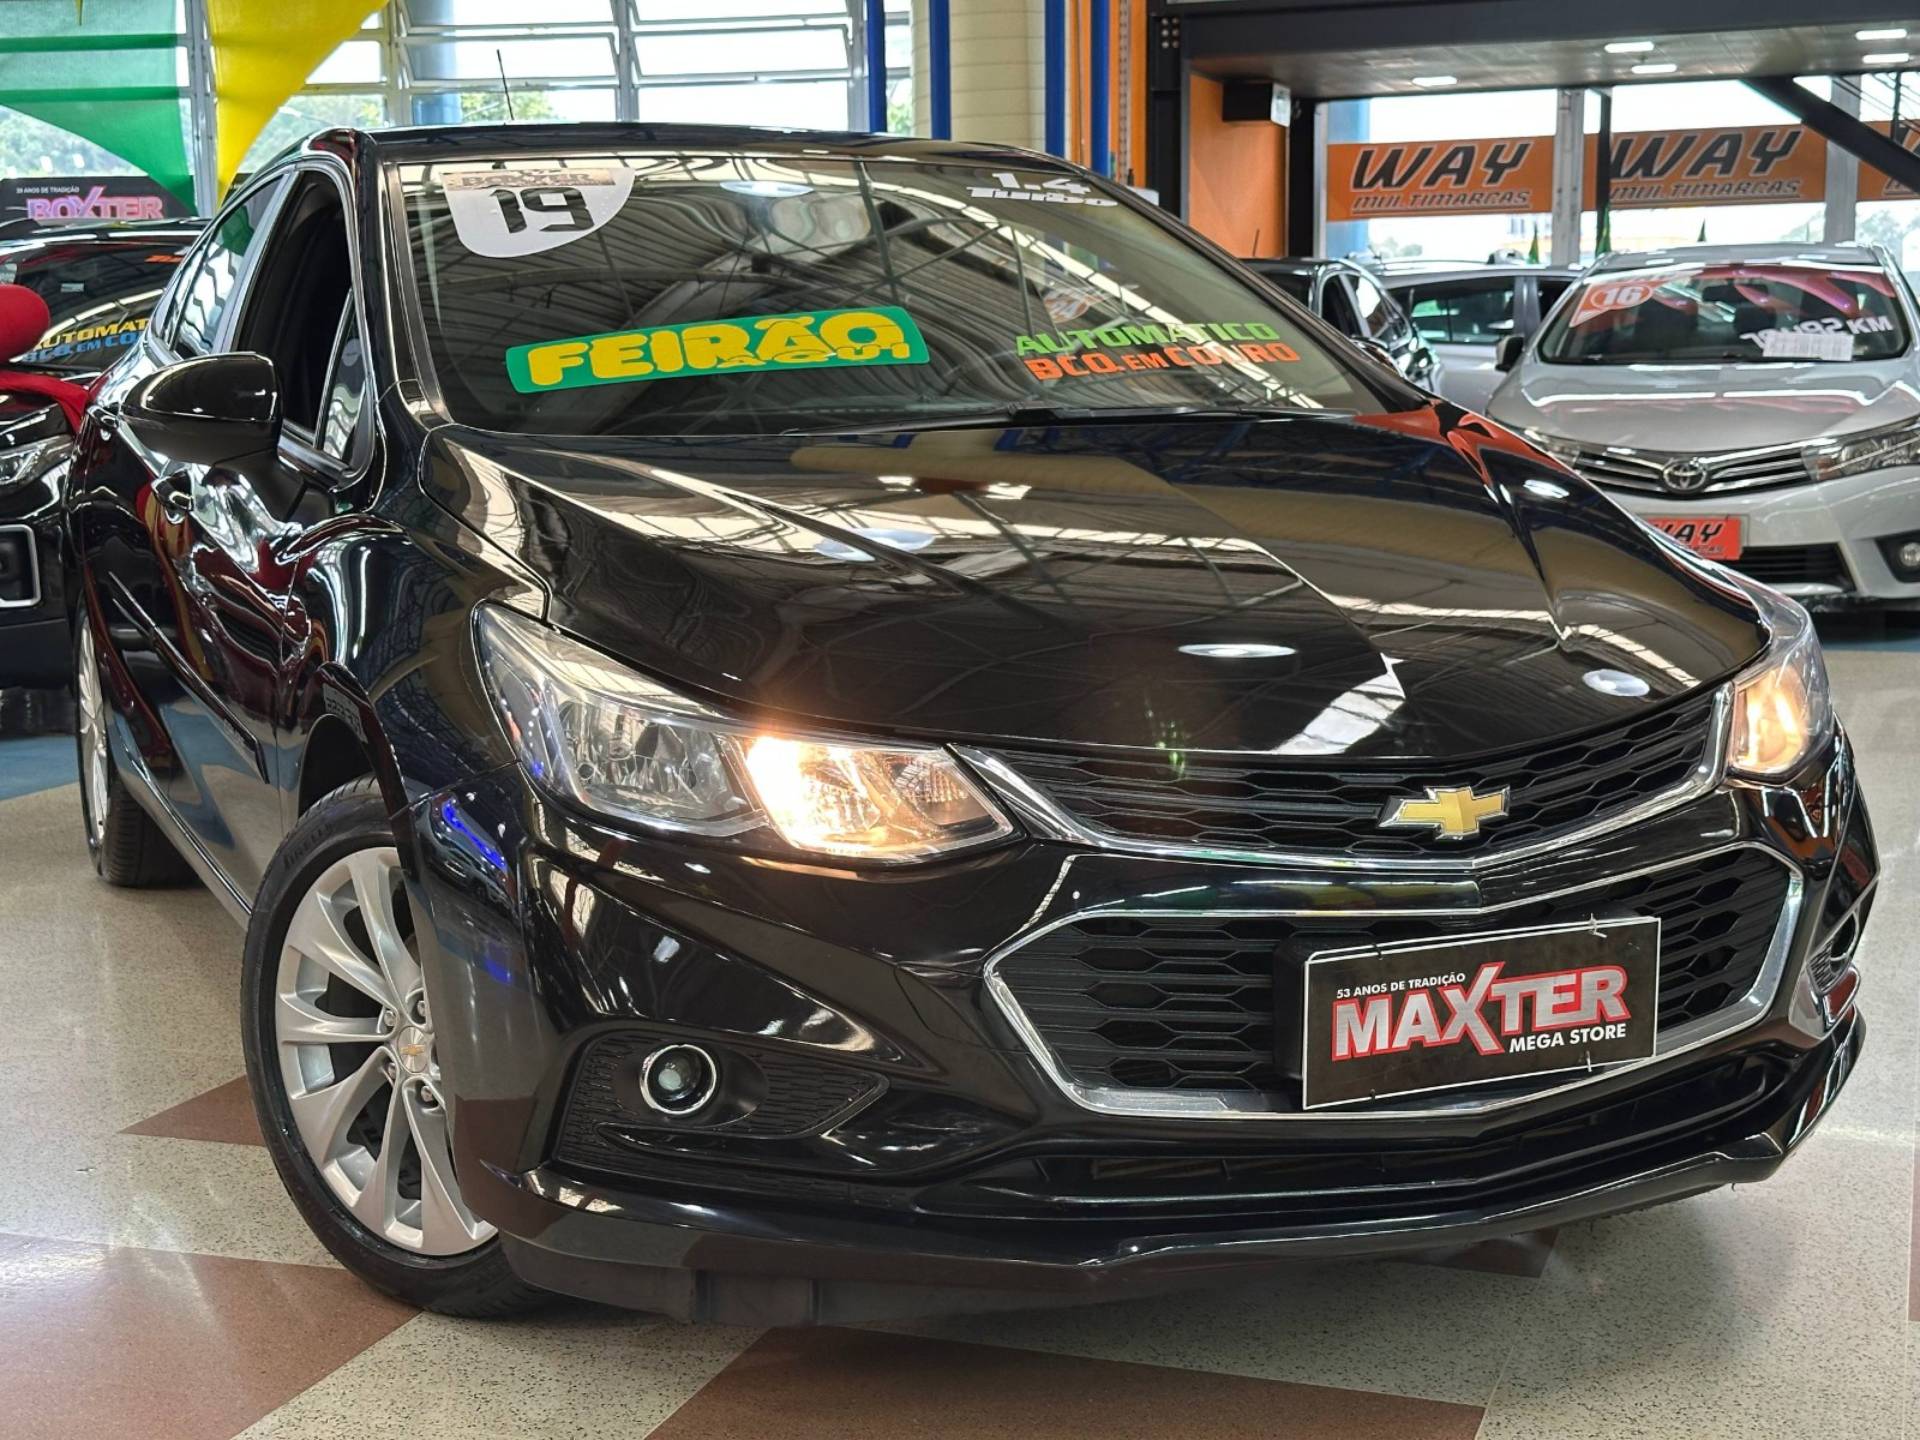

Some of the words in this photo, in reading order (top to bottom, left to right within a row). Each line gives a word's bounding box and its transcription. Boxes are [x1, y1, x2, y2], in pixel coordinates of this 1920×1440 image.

[1351, 140, 1534, 192] WAY
[1610, 128, 1803, 180] WAY
[992, 172, 1092, 195] 1.4
[1353, 189, 1531, 210] MULTIMARCAS
[26, 185, 164, 220] BOXTER
[490, 186, 595, 234] 19
[1603, 286, 1644, 306] 16
[34, 318, 149, 351] AUTOMAT
[1846, 315, 1894, 334] KM
[526, 312, 905, 386] FEIRÃO
[1120, 352, 1170, 372] EM
[1164, 341, 1300, 367] COURO
[1336, 988, 1351, 999] 53
[1353, 982, 1388, 997] ANOS
[1390, 980, 1406, 993] DE
[1407, 971, 1467, 990] TRADIÇÃO
[1331, 961, 1632, 1062] MAXTER
[1508, 1032, 1566, 1054] MEGA
[1568, 1022, 1628, 1045] STORE
